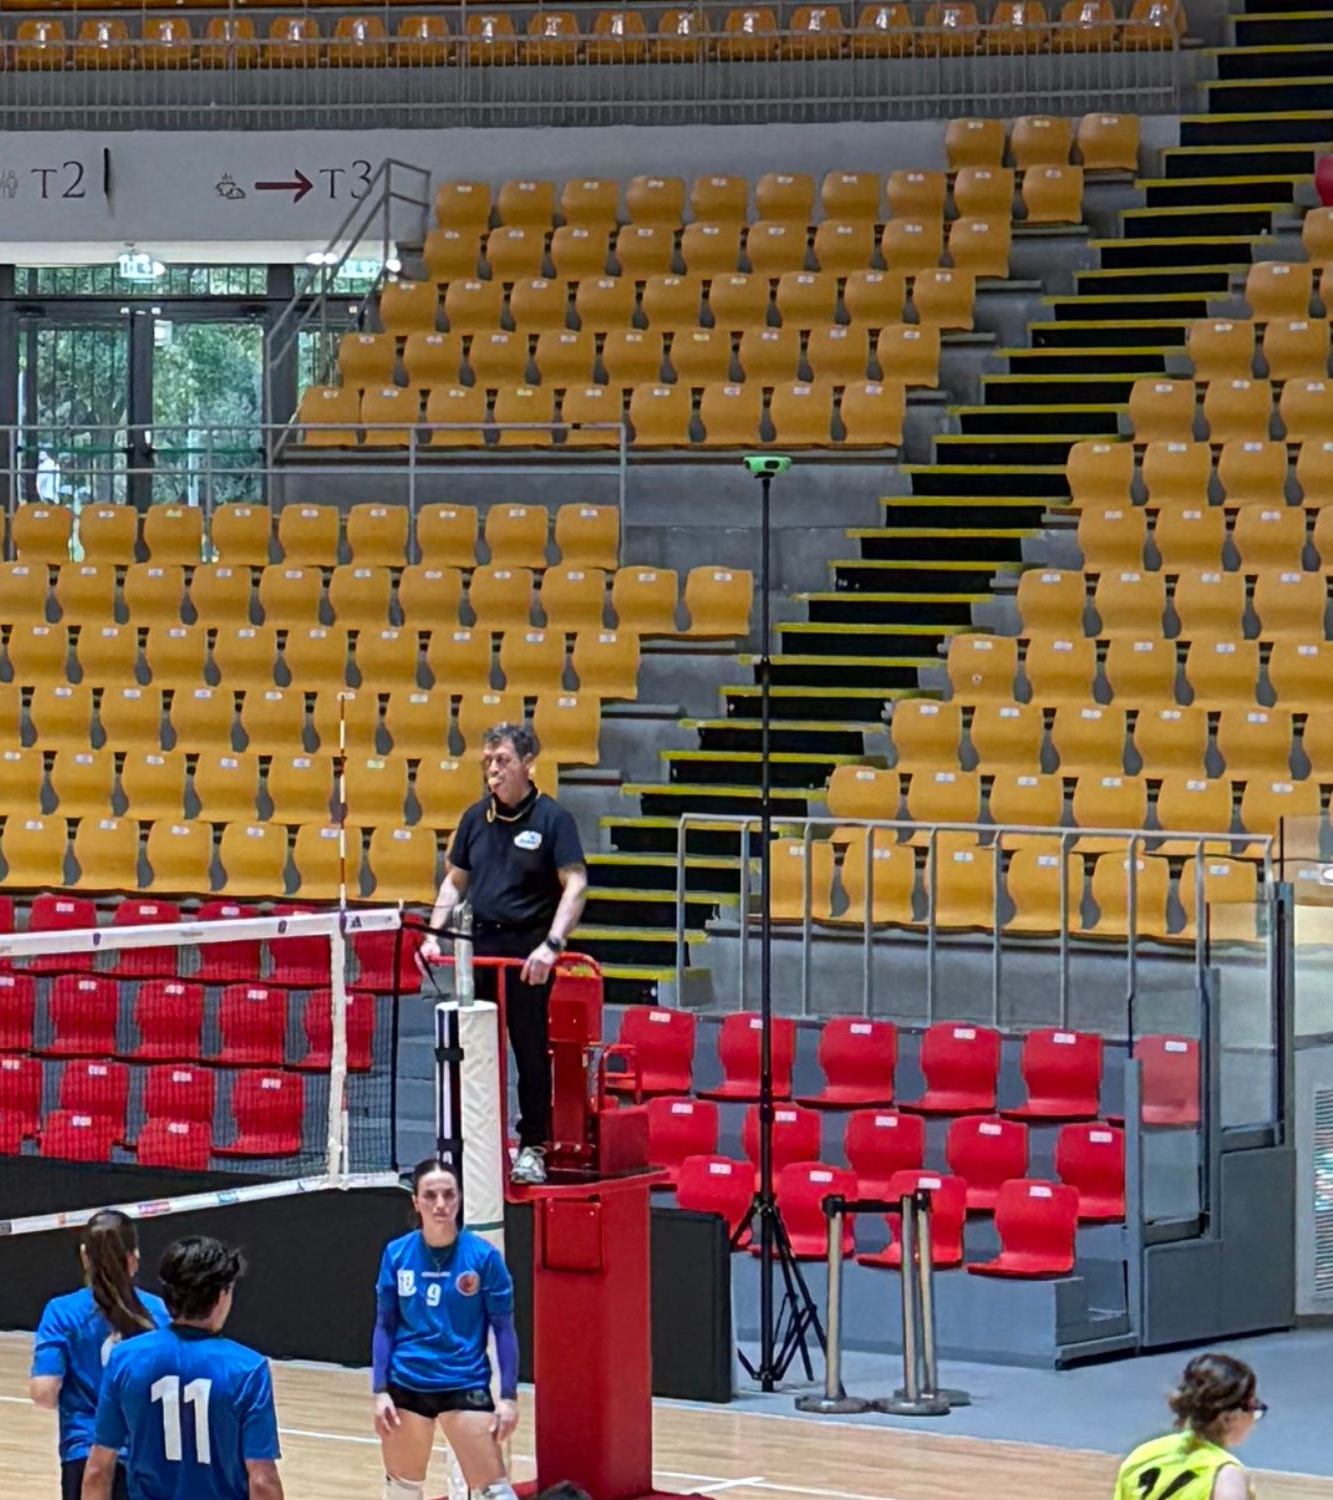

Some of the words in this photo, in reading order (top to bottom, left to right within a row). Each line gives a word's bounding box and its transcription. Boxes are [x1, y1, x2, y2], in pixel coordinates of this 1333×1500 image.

[30, 161, 86, 199] T2
[319, 160, 372, 200] T3
[427, 1283, 442, 1307] 9
[151, 1375, 213, 1465] 11
